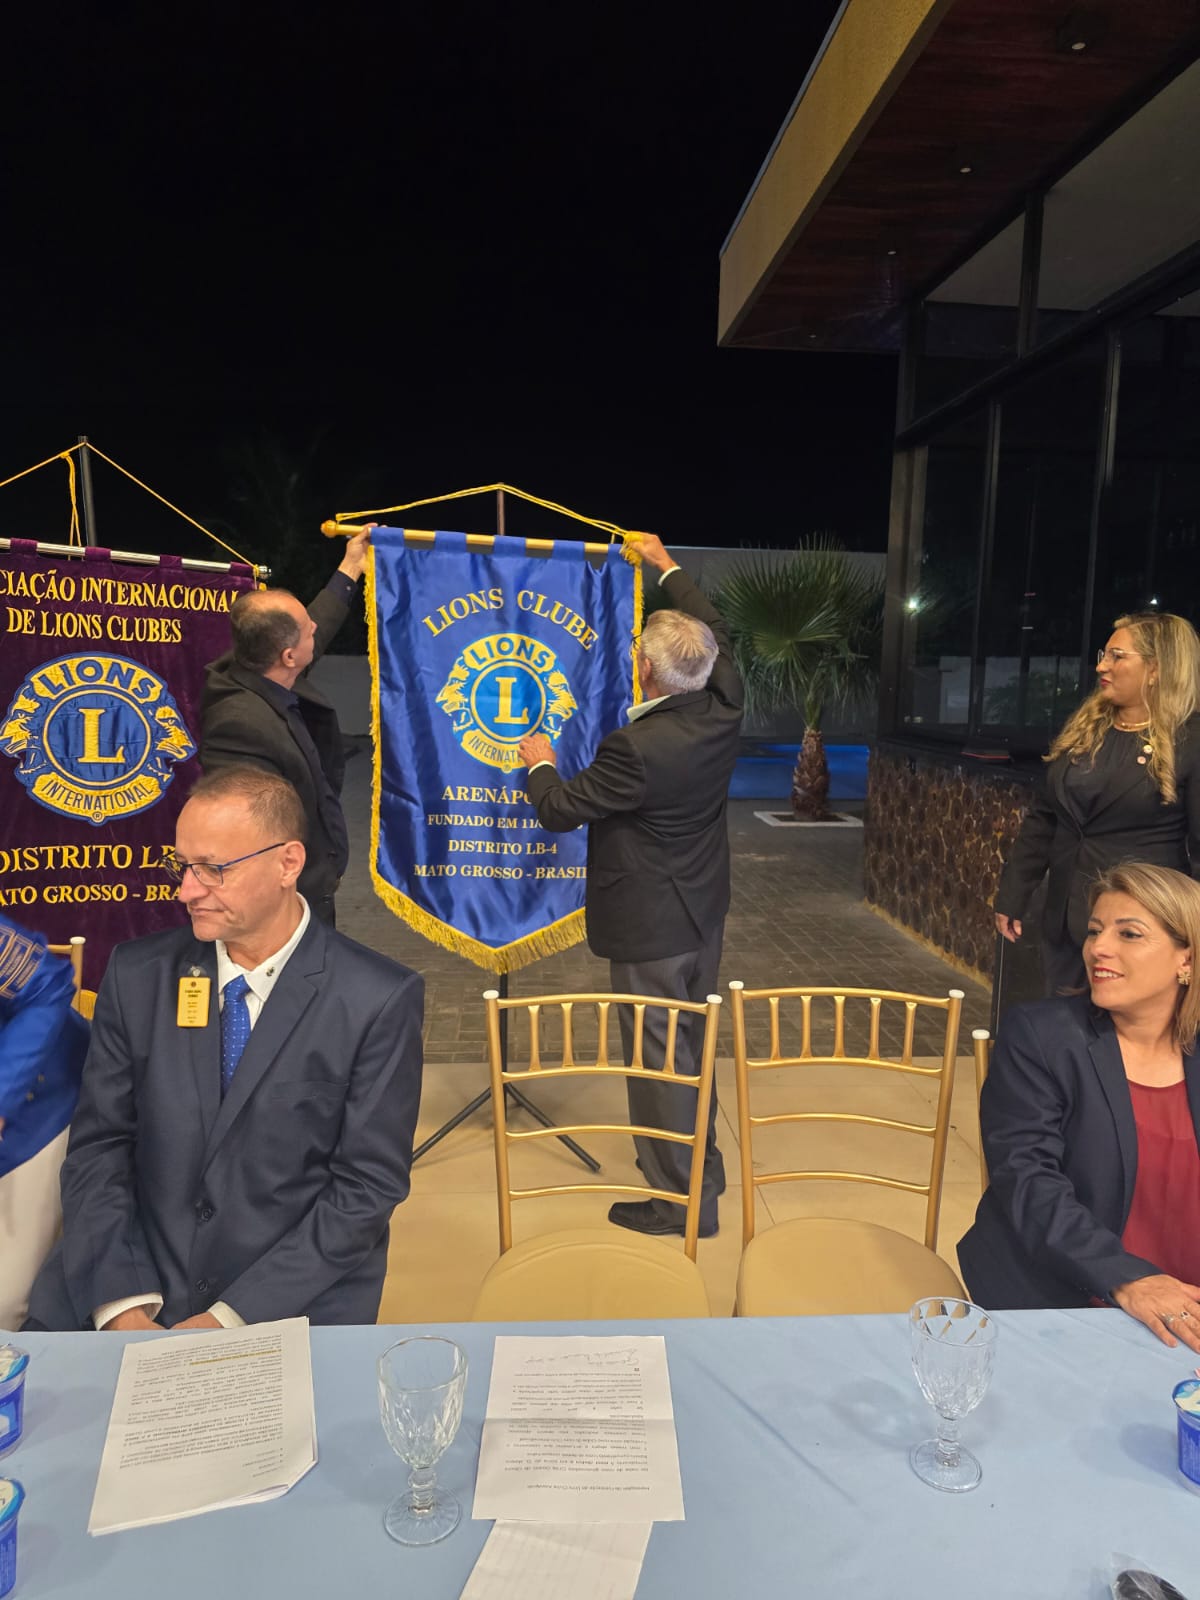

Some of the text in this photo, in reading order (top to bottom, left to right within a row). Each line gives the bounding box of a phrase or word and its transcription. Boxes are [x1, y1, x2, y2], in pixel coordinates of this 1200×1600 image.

[6, 607, 182, 643] DE LIONS CLUBES
[422, 588, 599, 650] LIONS CLUBE
[470, 637, 550, 668] LIONS
[38, 659, 156, 698] LIONS
[493, 676, 529, 724] L
[77, 708, 126, 763] L
[41, 779, 154, 811] INTERNATIONAL
[427, 814, 494, 827] FUNDADO
[497, 817, 517, 829] EM
[448, 839, 558, 855] DISTRITO LB-4
[413, 864, 457, 877] MATO
[461, 865, 524, 879] GROSSO
[43, 884, 128, 903] GROSSO
